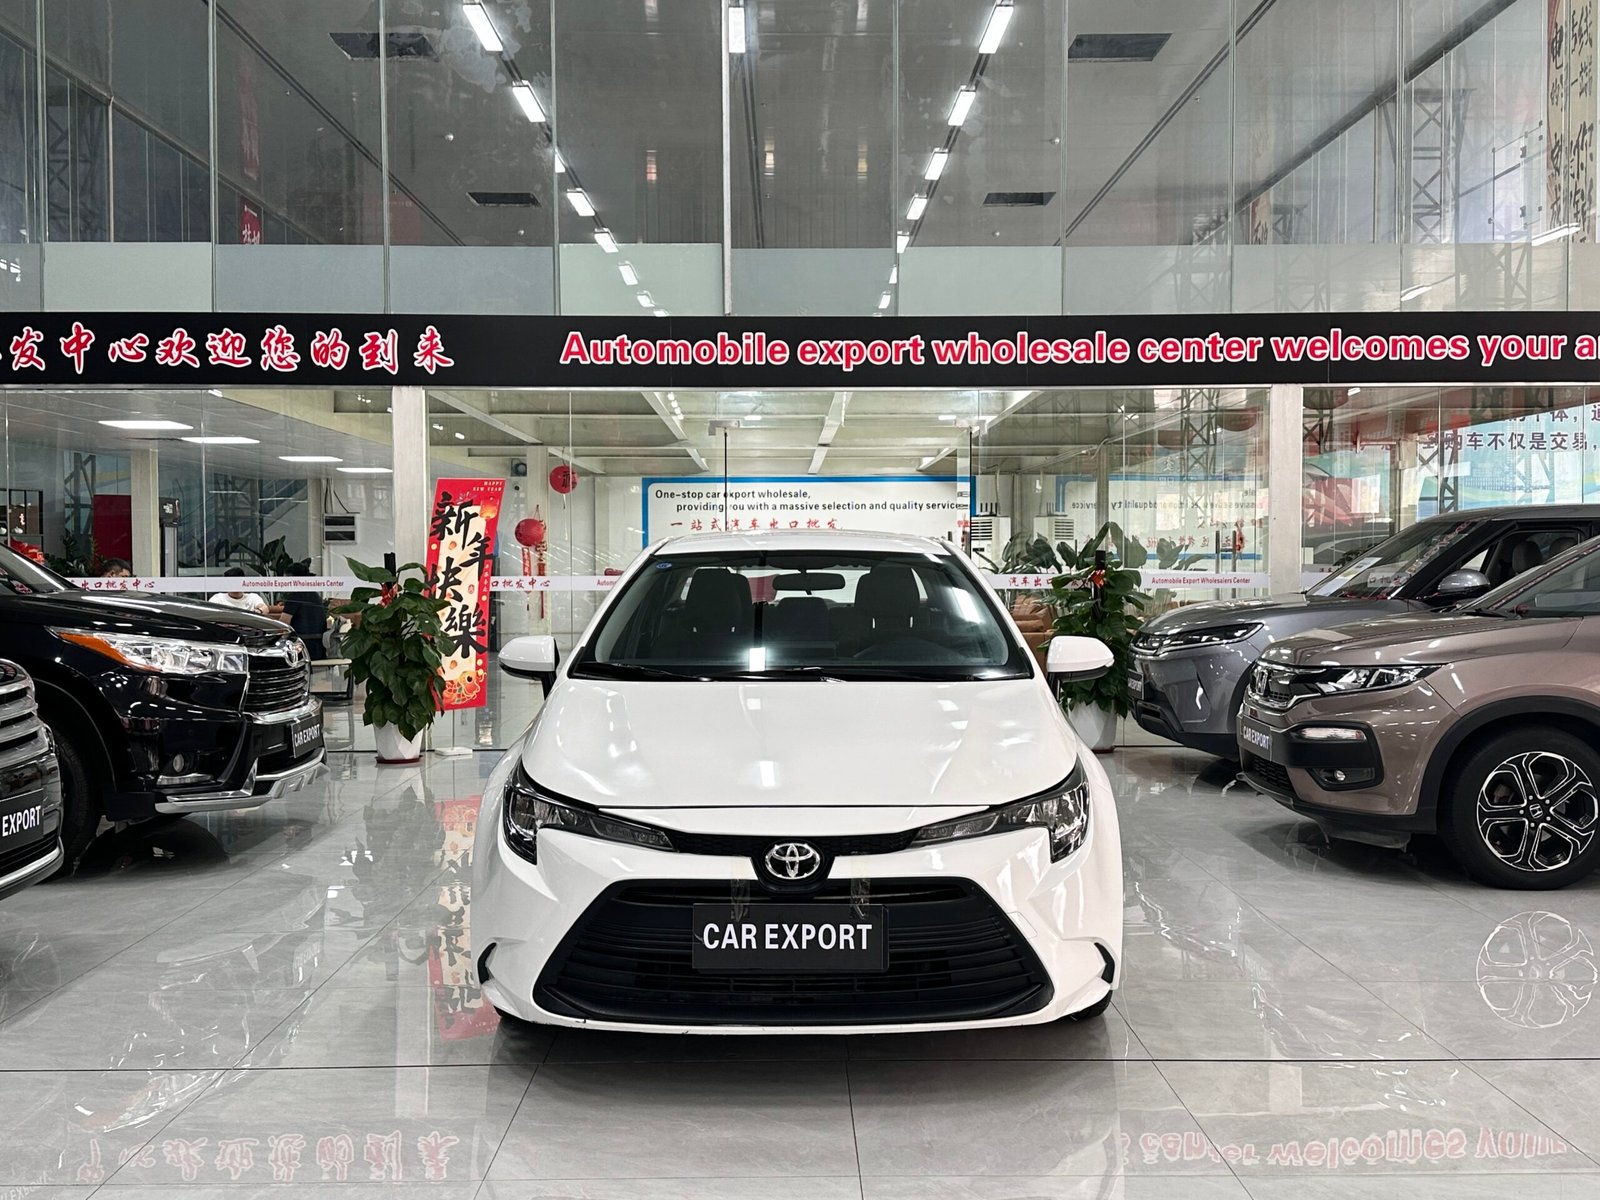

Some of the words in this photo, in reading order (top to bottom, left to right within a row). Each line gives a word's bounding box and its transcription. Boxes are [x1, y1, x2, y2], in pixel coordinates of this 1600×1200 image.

[0, 322, 455, 373] 发中心欢迎您的到来
[560, 331, 790, 365] Automobile
[797, 335, 925, 371] export
[931, 331, 1130, 364] wholesale
[1138, 332, 1264, 363] center
[1270, 328, 1470, 361] welcomes
[1477, 335, 1567, 366] your
[1574, 335, 1600, 360] a
[655, 489, 704, 501] One-stop
[705, 491, 721, 499] car
[757, 489, 811, 499] wholesale,
[676, 502, 724, 512] providing
[747, 502, 769, 510] with
[780, 502, 820, 510] massive
[822, 501, 867, 510] selection
[869, 501, 887, 510] and
[890, 501, 924, 512] quality
[71, 578, 155, 592] 出口批发中心
[274, 580, 292, 588] Export
[1182, 577, 1200, 585] Export
[294, 731, 303, 747] CAR
[303, 723, 320, 744] EXPORT
[1243, 725, 1251, 742] CAR
[1251, 728, 1270, 750] EXPORT
[2, 805, 41, 837] EXPORT
[703, 923, 757, 950] CAR
[765, 923, 873, 950] EXPORT
